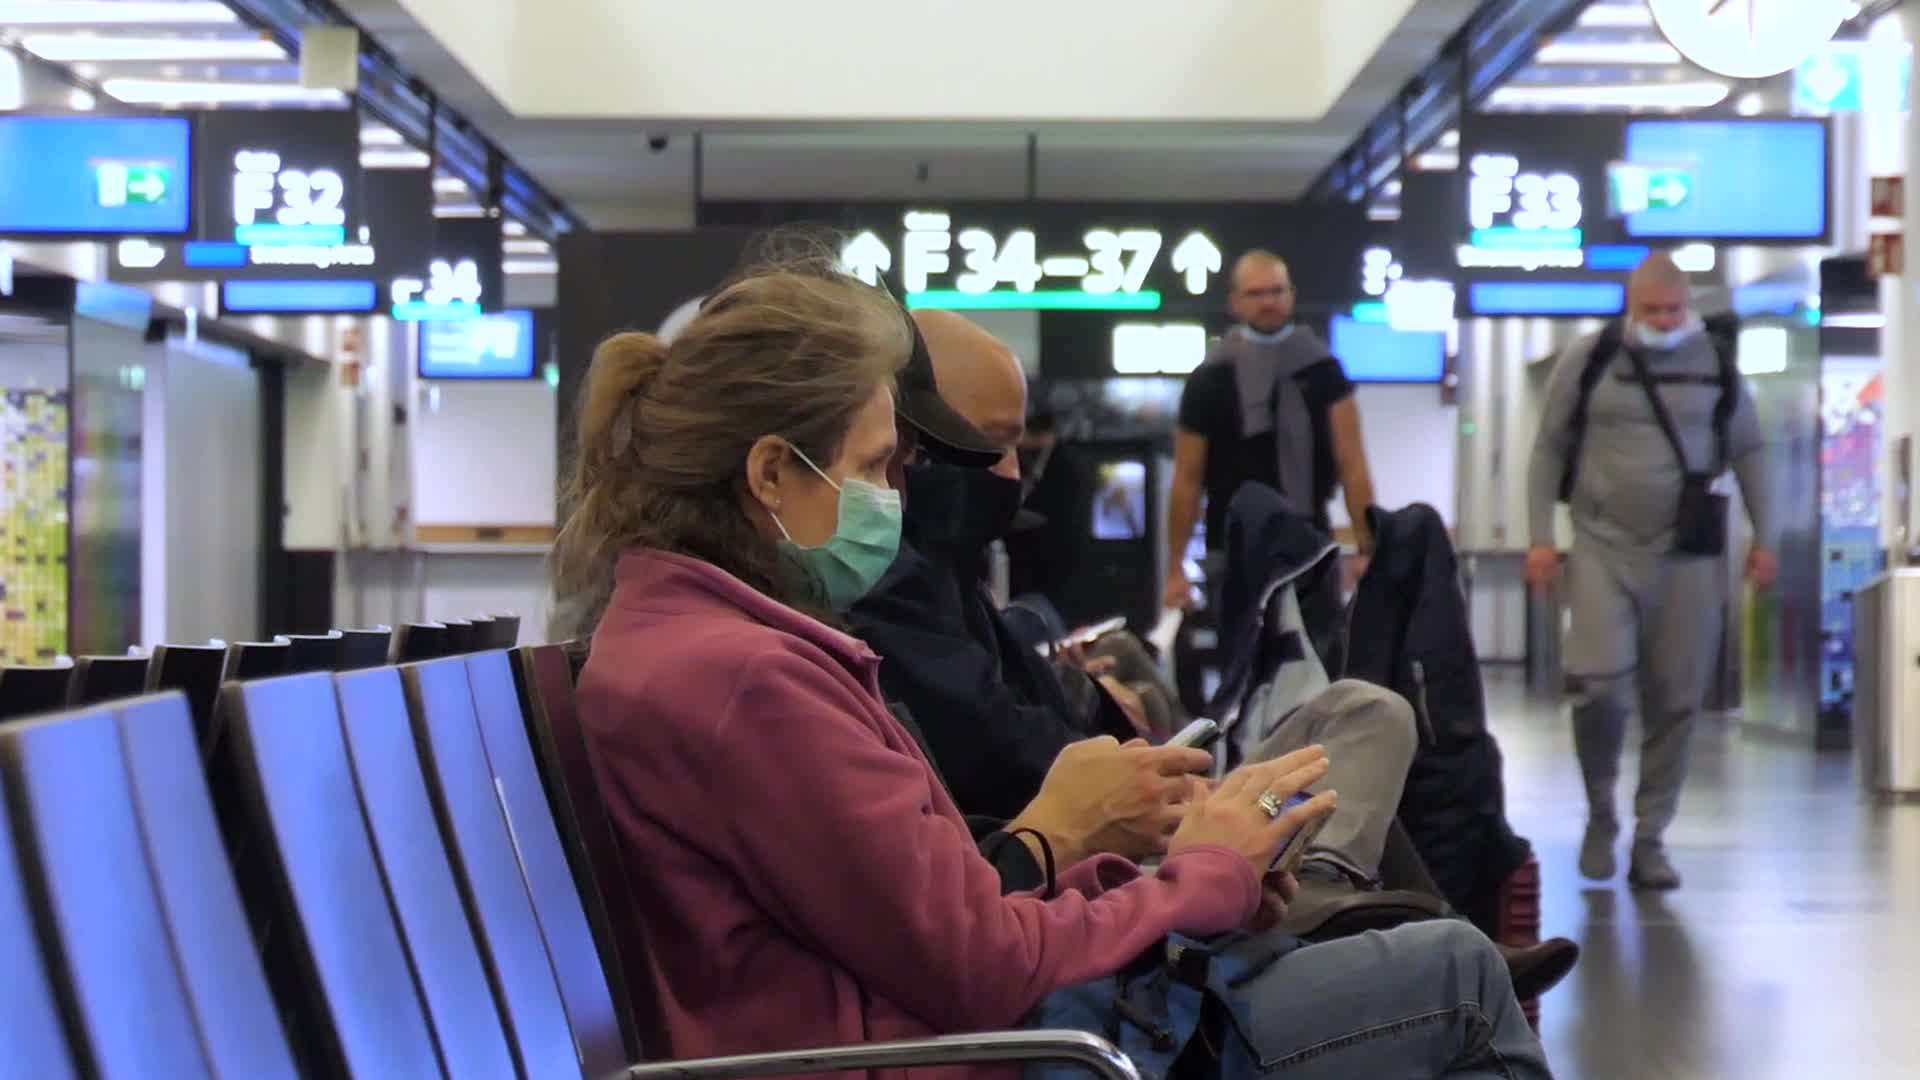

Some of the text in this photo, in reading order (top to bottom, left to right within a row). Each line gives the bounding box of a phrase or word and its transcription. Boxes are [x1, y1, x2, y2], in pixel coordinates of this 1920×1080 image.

[234, 170, 345, 225] F 32
[1470, 172, 1582, 229] F 33
[424, 260, 482, 304] 34
[904, 231, 950, 294] F
